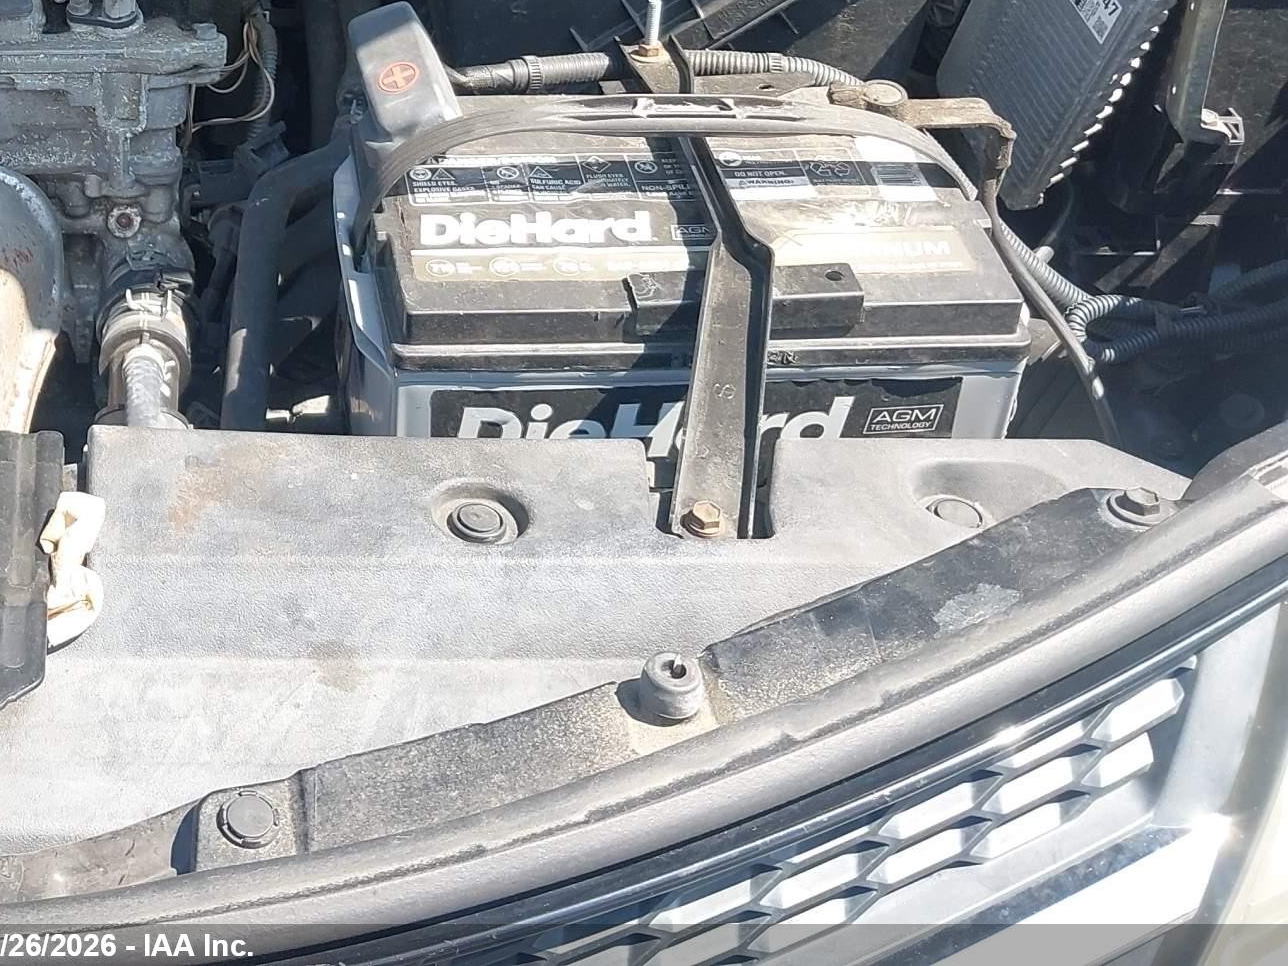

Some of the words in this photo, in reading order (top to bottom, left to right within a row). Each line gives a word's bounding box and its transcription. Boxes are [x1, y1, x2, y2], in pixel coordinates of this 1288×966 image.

[872, 408, 937, 423] AGM
[457, 396, 855, 458] DieHrd
[871, 421, 932, 431] TECHNOLOGY
